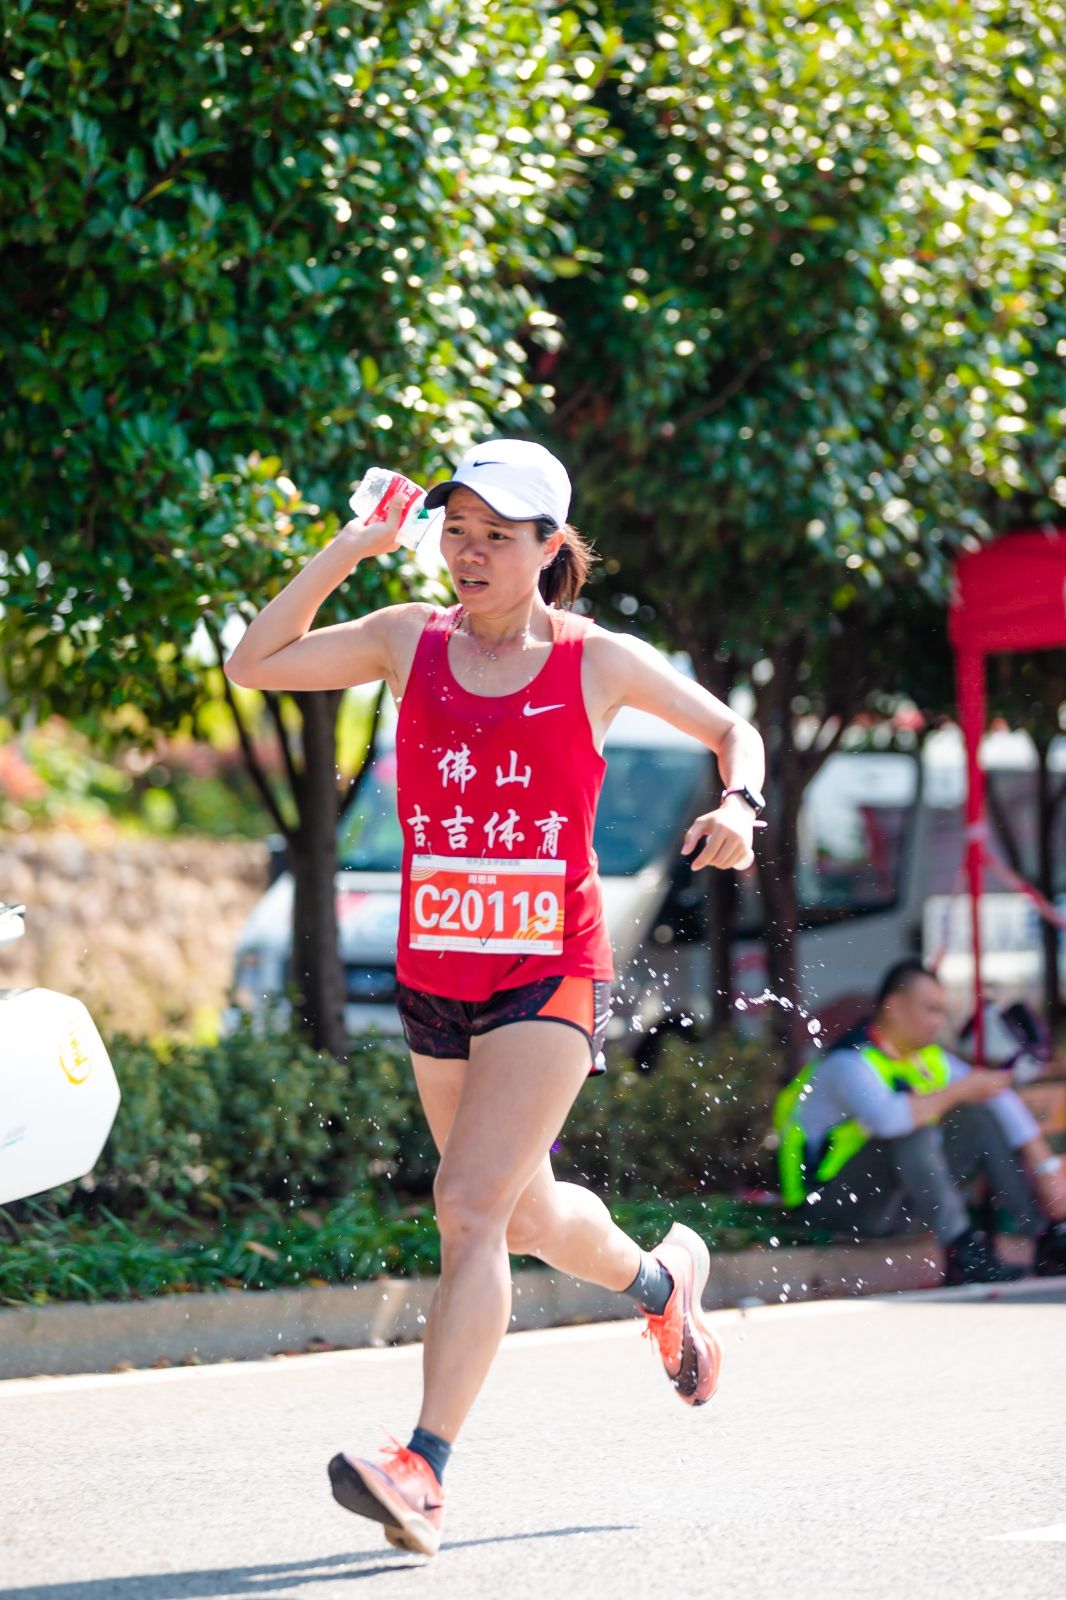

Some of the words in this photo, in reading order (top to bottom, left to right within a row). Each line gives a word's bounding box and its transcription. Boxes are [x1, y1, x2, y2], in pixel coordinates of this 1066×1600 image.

[438, 743, 531, 793] 佛山
[406, 804, 568, 857] 吉吉体育
[414, 884, 558, 933] C20119
